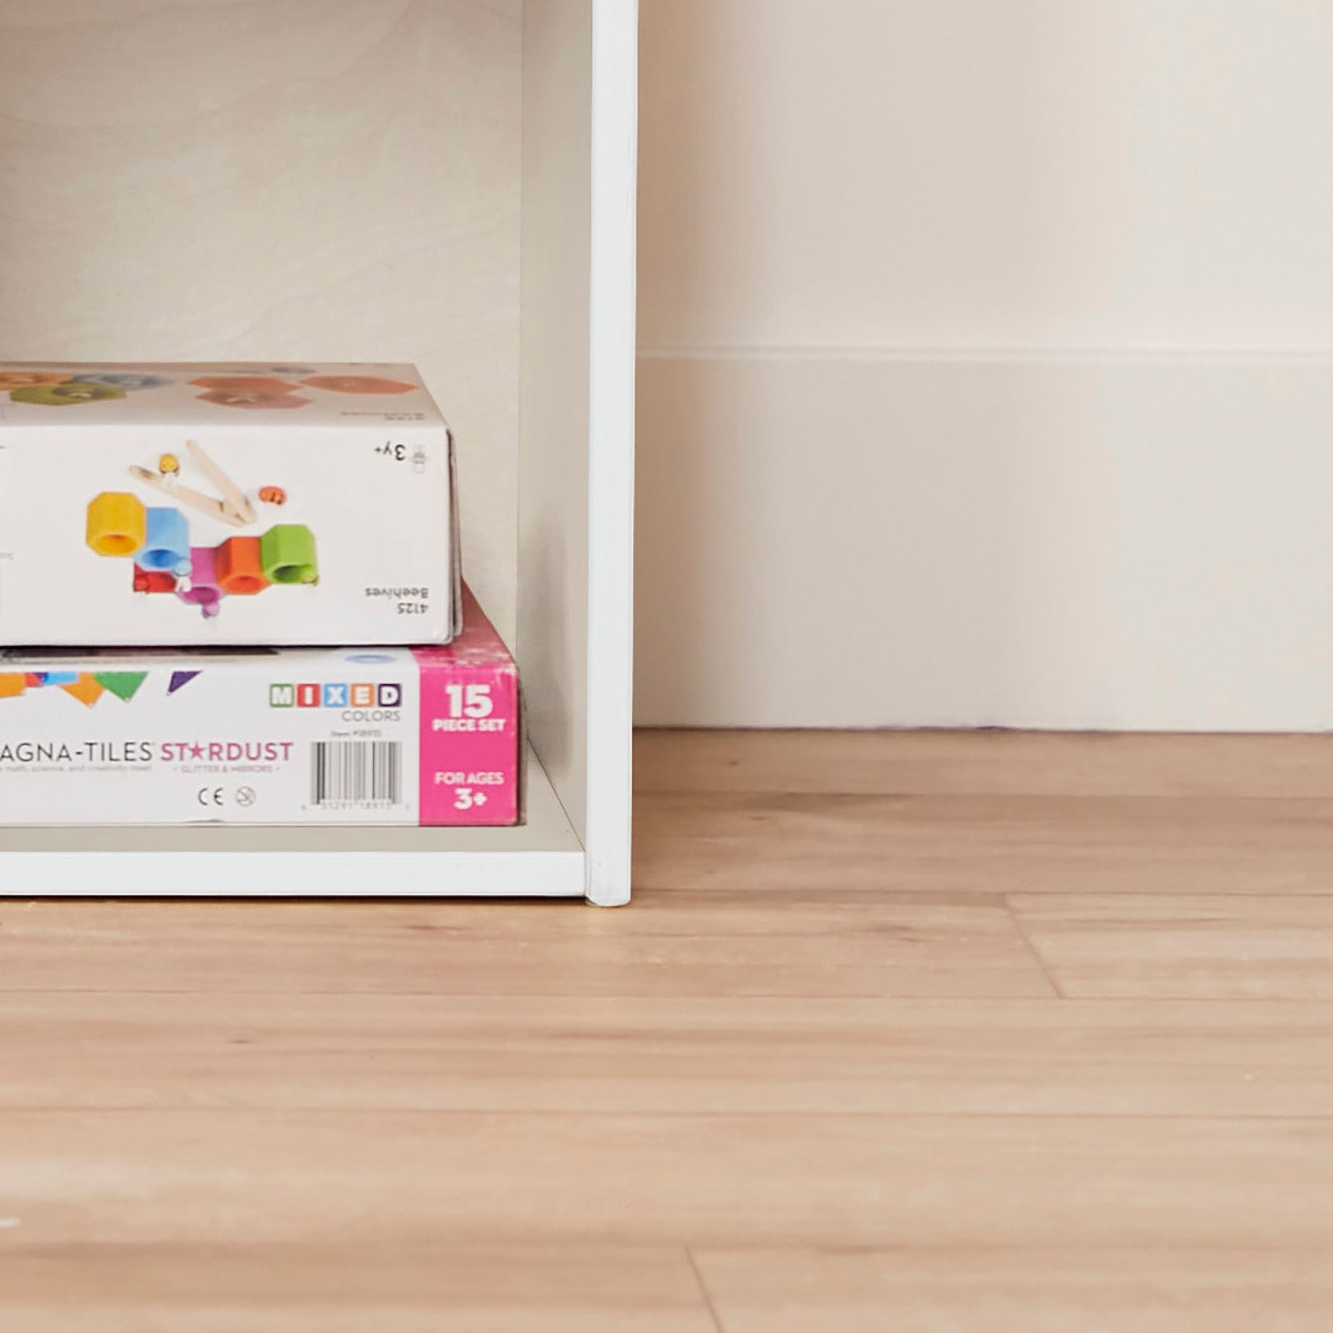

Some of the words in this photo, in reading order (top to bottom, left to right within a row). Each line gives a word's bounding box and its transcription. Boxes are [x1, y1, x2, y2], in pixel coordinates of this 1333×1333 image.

[374, 441, 406, 461] 3y+
[365, 587, 428, 599] Beehives
[398, 602, 428, 614] 4125
[271, 684, 400, 706] MIXED
[446, 683, 493, 718] 15
[341, 710, 400, 722] COLORS
[433, 719, 476, 731] PIECE
[478, 719, 505, 731] SET
[435, 772, 461, 784] FOR
[463, 772, 503, 784] AGES
[454, 788, 487, 809] 3+
